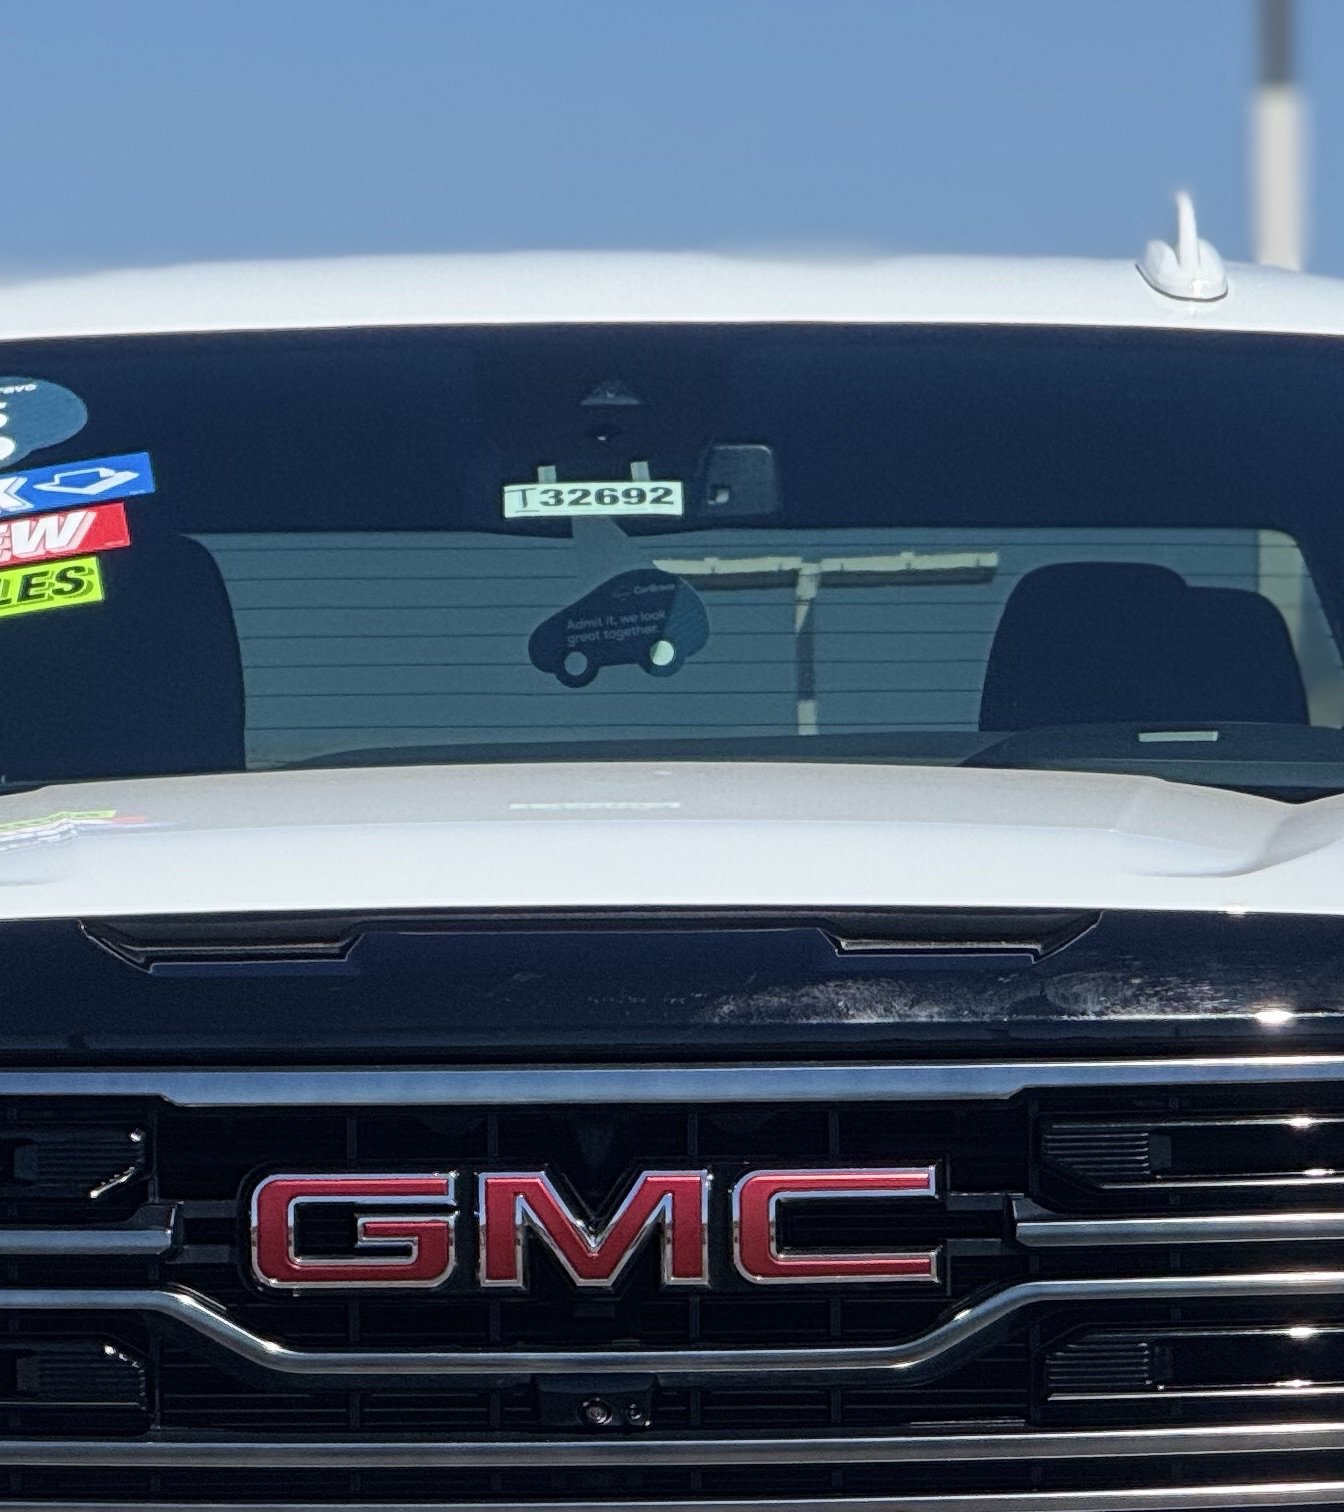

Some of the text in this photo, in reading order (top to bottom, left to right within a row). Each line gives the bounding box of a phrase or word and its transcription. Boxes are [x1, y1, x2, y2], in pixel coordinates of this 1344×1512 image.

[567, 616, 604, 630] Admit
[640, 610, 666, 621] look
[251, 1167, 939, 1290] GMC
